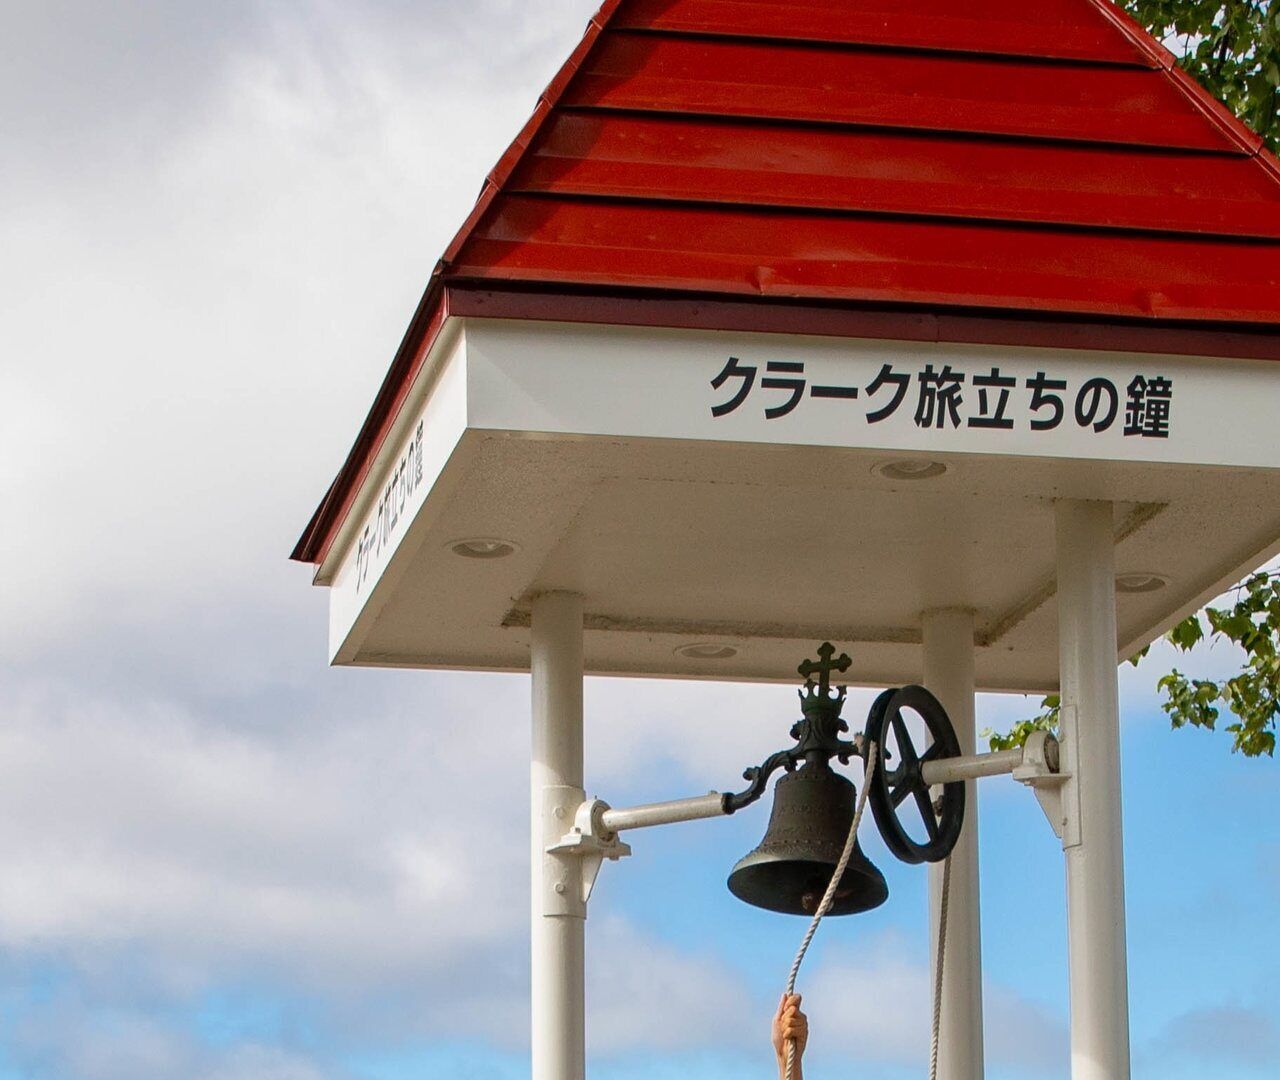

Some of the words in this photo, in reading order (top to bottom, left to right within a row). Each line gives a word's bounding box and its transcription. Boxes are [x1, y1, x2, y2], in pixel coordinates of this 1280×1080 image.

[710, 356, 1173, 439] クラーク旅立ちの鐘
